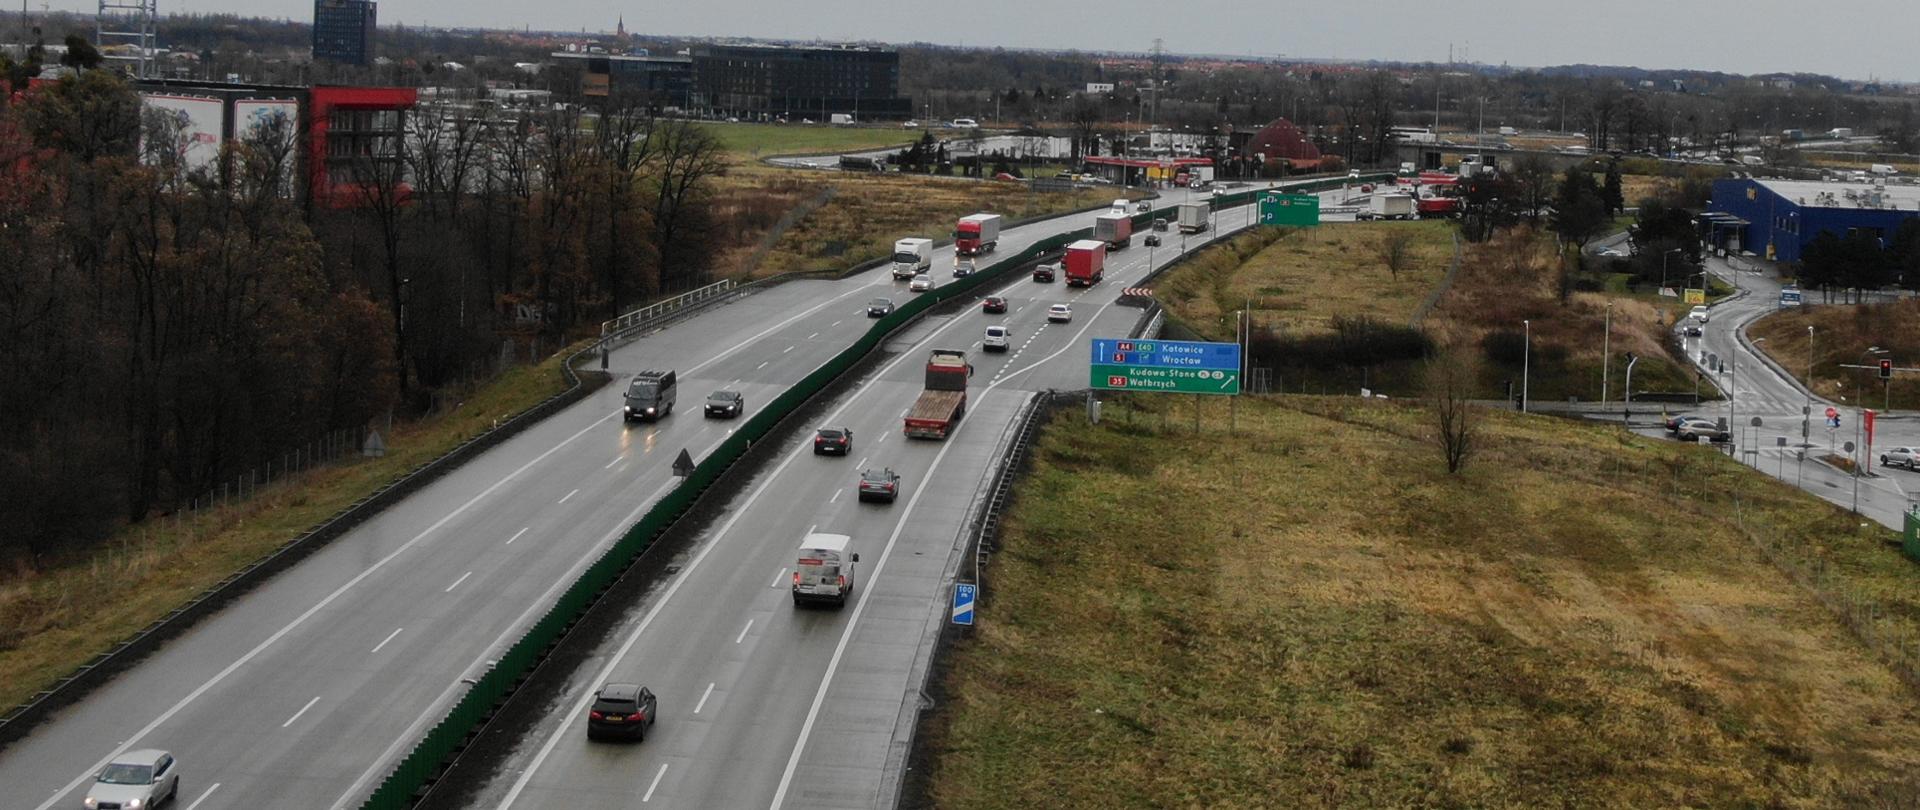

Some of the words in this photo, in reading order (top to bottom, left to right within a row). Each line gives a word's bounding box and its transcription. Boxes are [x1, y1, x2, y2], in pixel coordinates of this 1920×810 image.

[1120, 343, 1130, 351] A4
[1138, 343, 1152, 351] E40
[1162, 344, 1203, 354] Katowice
[1162, 355, 1201, 365] Wrocław
[1130, 379, 1176, 389] Wałbrzych
